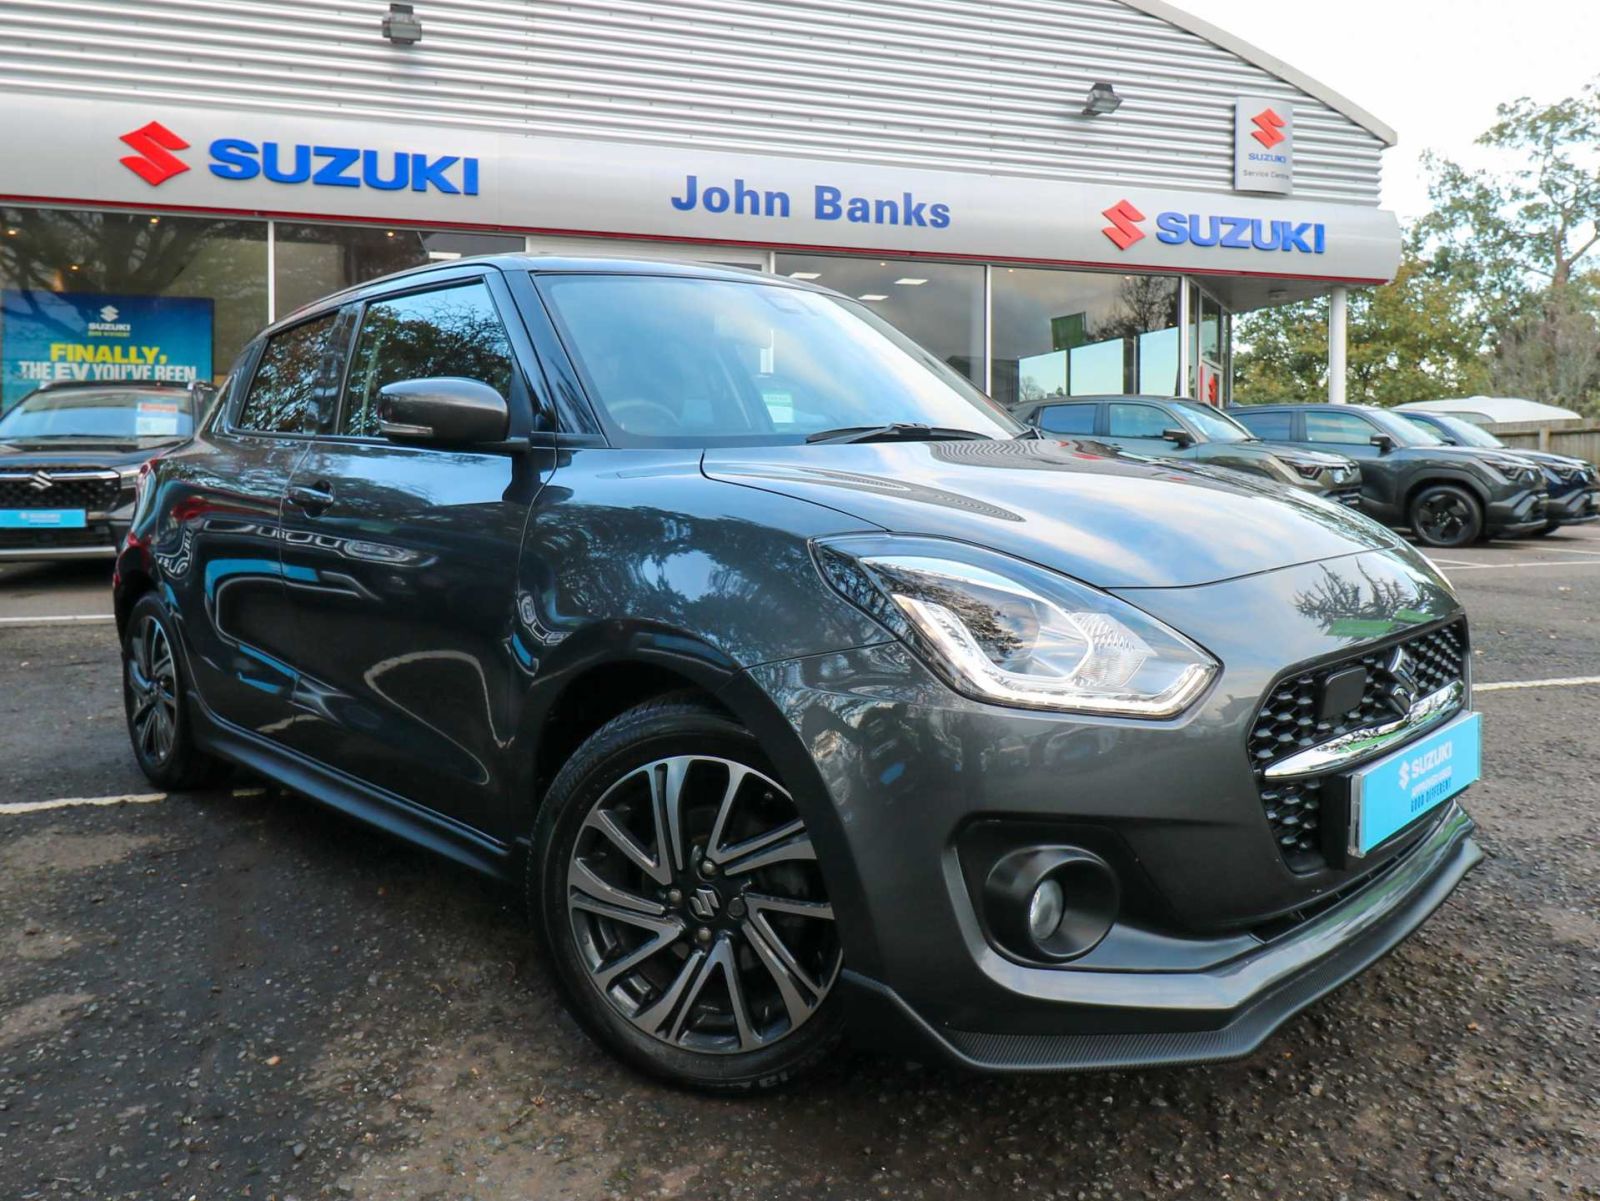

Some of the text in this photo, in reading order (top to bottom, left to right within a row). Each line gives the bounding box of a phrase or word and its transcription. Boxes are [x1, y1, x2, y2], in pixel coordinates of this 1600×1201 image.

[208, 138, 479, 196] SUZUKI
[1248, 152, 1287, 163] SUZUKI
[671, 175, 951, 229] John Banks
[1156, 211, 1325, 254] SUZUKI
[88, 322, 131, 332] SUZUKI
[51, 343, 168, 365] FINALLY,
[19, 361, 50, 380] THE
[53, 362, 91, 381] EV
[92, 364, 151, 381] YOU'VE
[1411, 740, 1453, 779] SUZUKI
